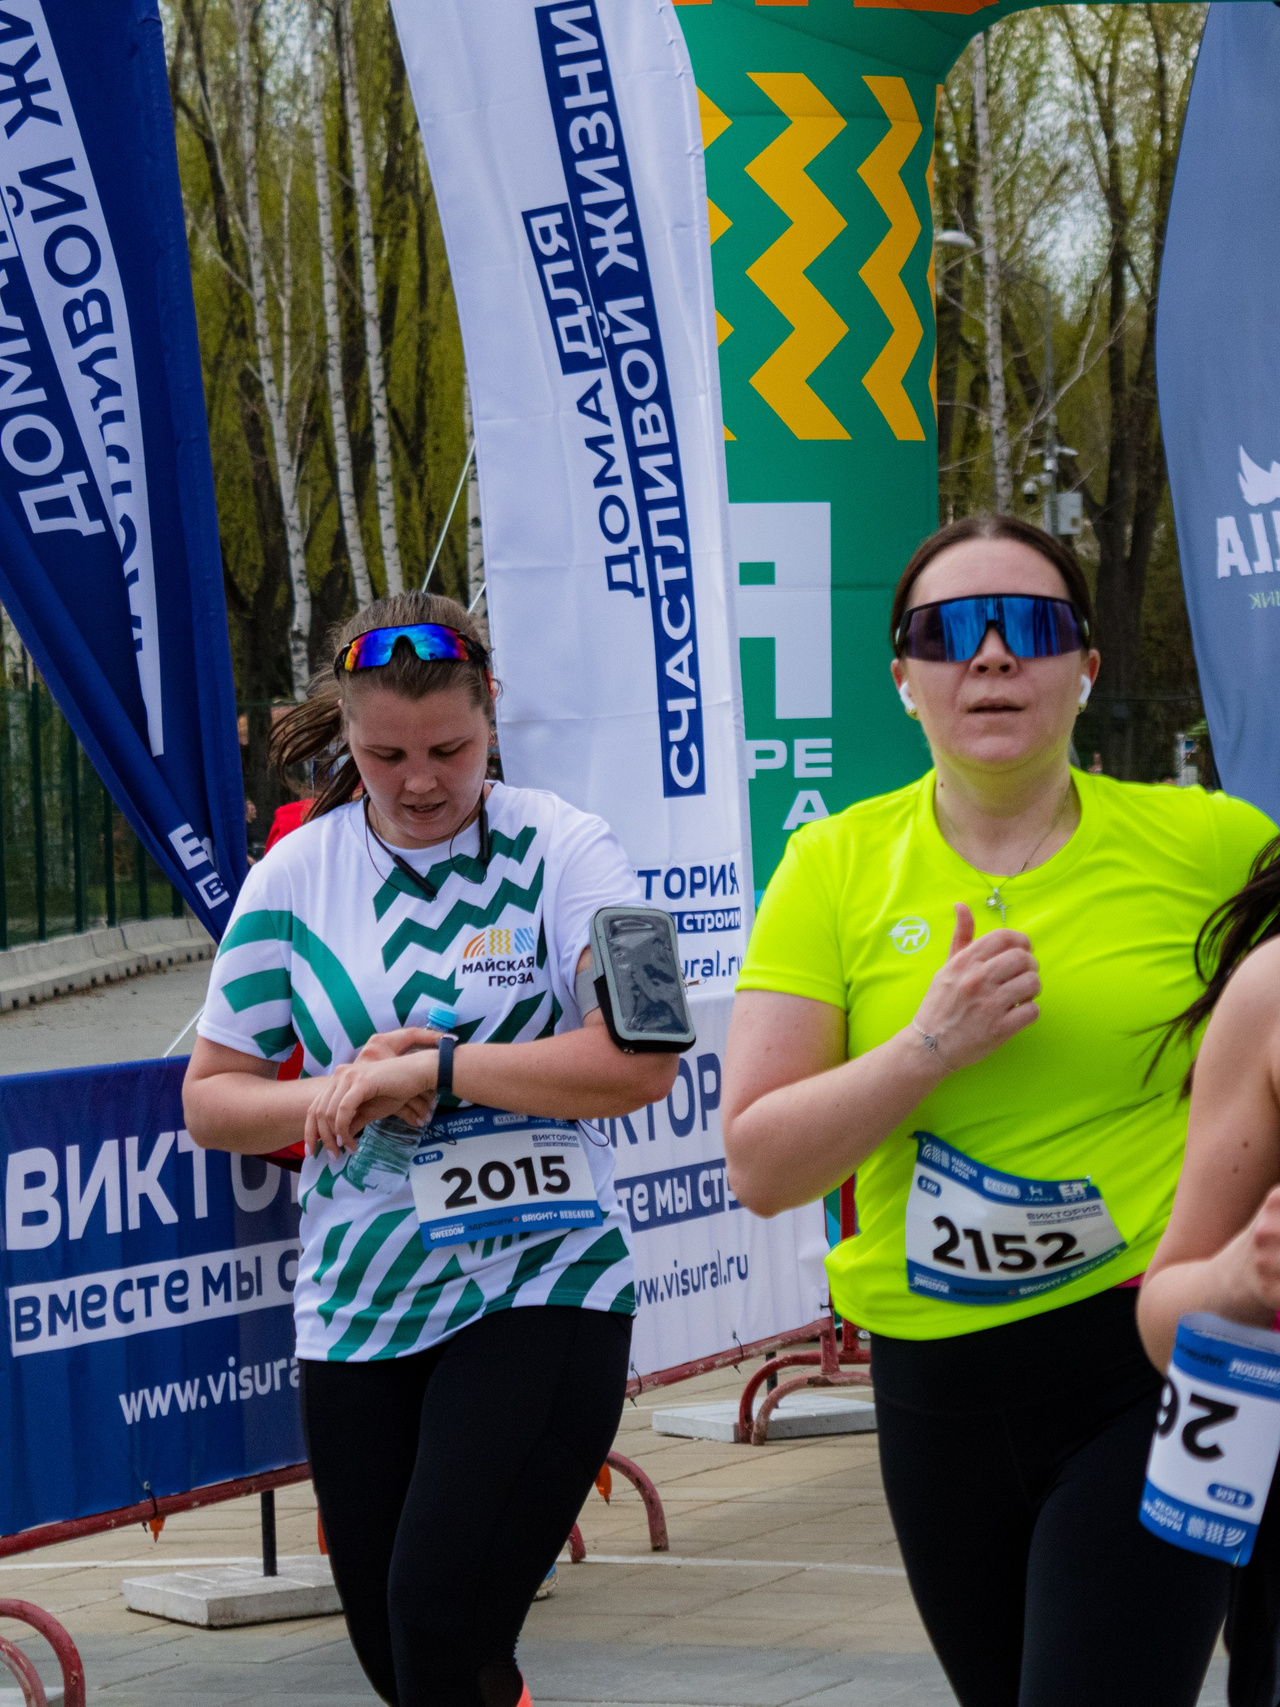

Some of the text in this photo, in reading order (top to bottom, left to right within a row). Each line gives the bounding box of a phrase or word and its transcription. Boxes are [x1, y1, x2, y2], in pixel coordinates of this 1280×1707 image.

[530, 212, 646, 598] ДОМА ДЛЯ
[550, 5, 700, 789] СЧАСТЛИВОЙ ЖИЗНИ
[637, 862, 740, 901] ТОРИЯ
[462, 956, 535, 975] МАЙСКАЯ
[488, 972, 535, 987] ГРОЗА
[532, 1134, 578, 1142] ВИКТОРИЯ
[6, 1129, 299, 1250] ВИКТО
[440, 1155, 571, 1210] 2015
[656, 1169, 692, 1217] мы
[430, 1226, 466, 1240] SWEEDOM
[932, 1215, 1085, 1274] 2152
[14, 1269, 190, 1343] вместе
[202, 1255, 263, 1307] мы
[119, 1356, 300, 1425] www.visura
